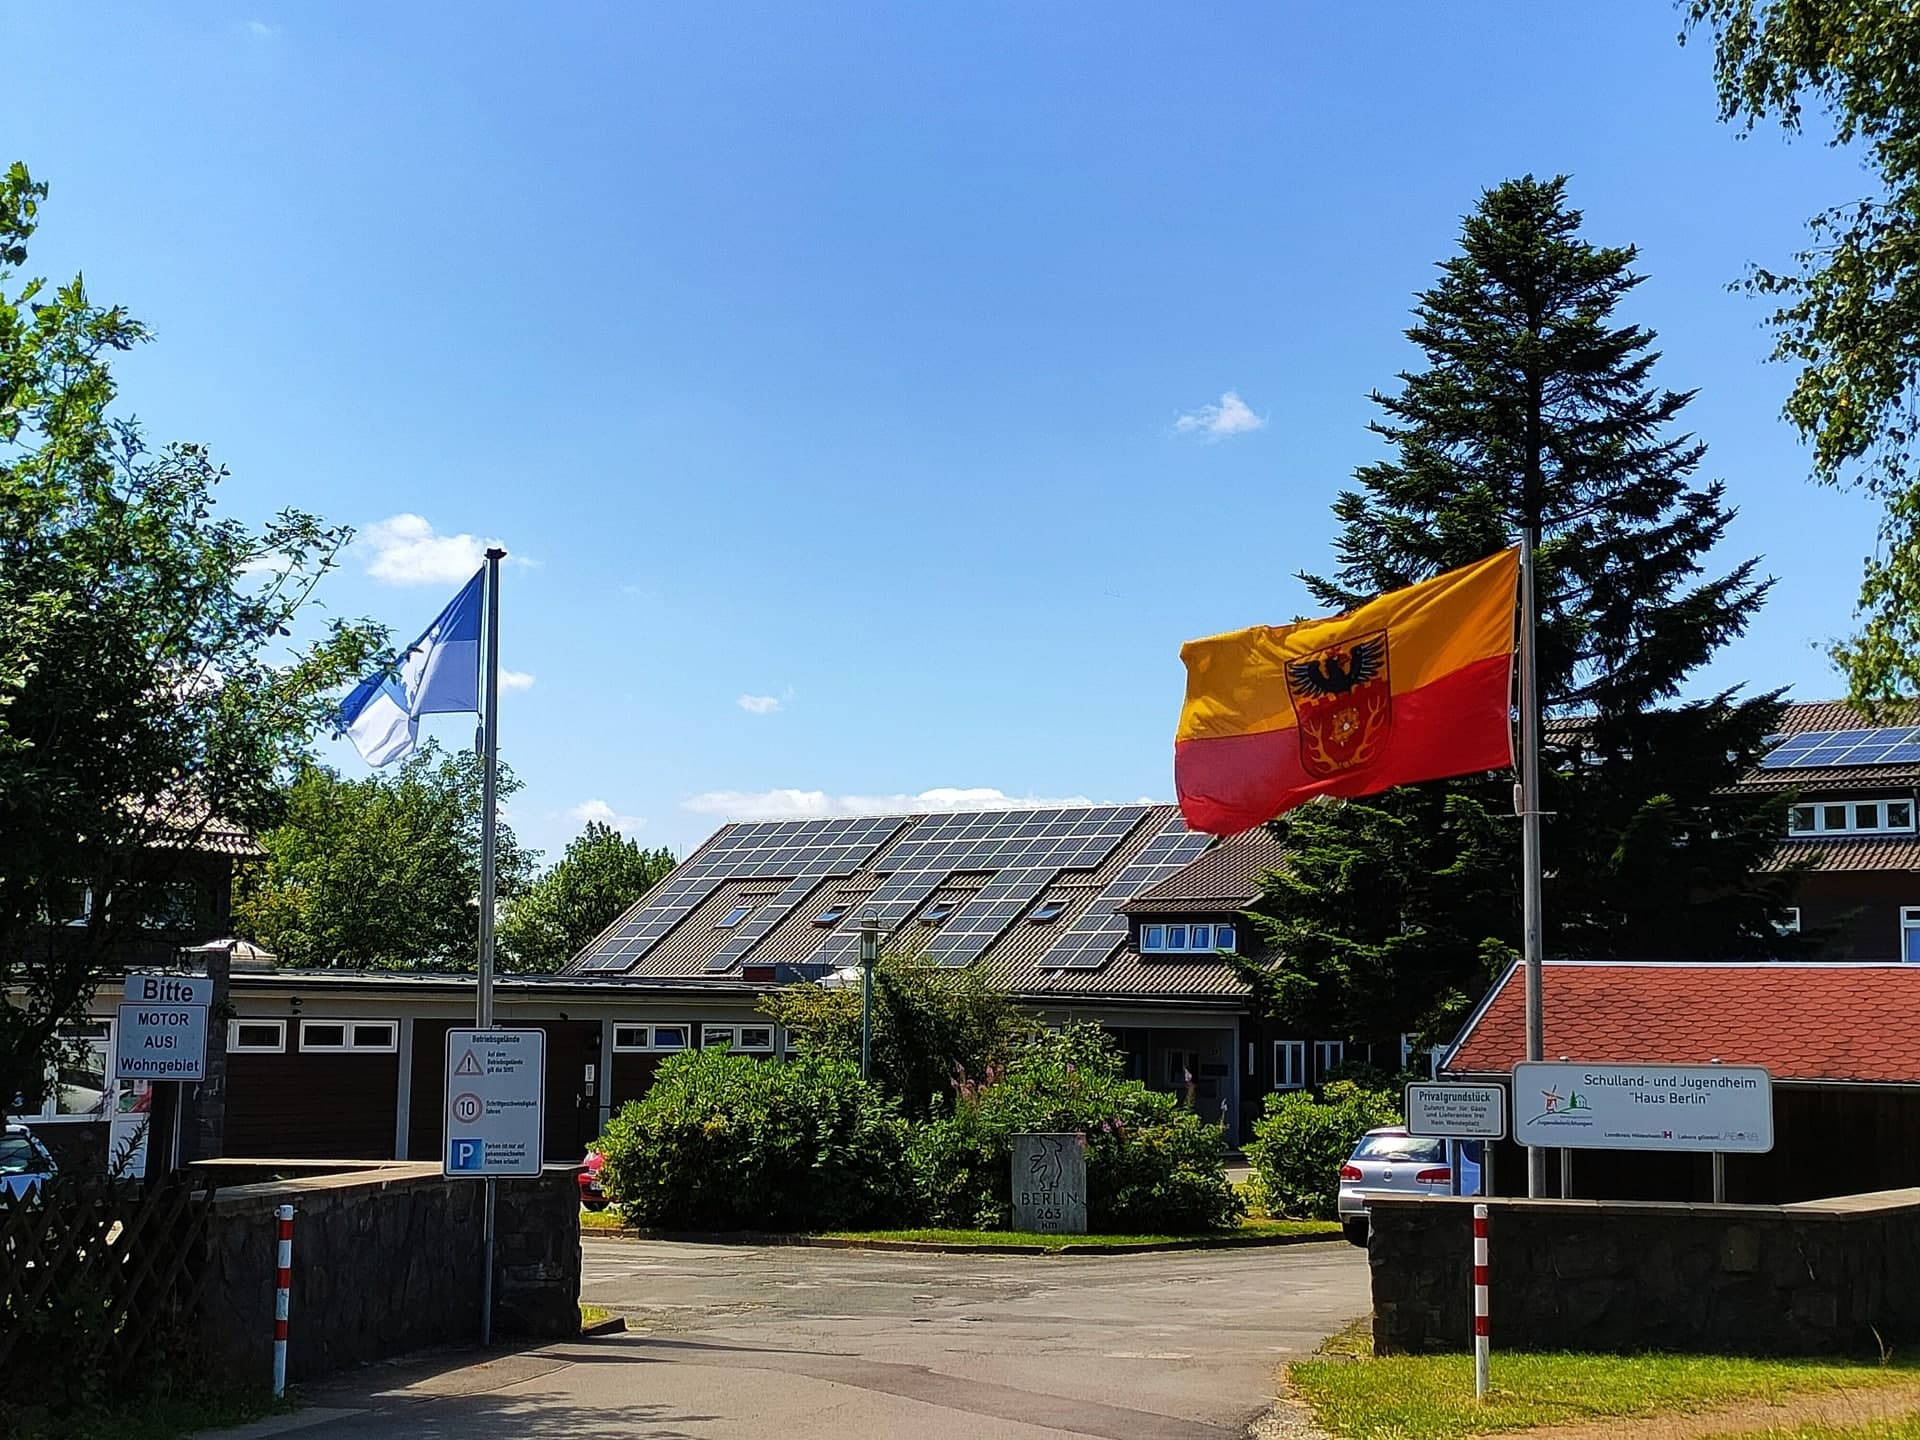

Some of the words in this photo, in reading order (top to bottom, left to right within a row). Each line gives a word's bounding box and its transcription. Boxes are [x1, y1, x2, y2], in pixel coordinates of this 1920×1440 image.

[143, 979, 194, 1002] Bitte
[138, 1013, 190, 1026] MOTOR
[120, 1057, 200, 1073] Wohngebiet
[1584, 1074, 1649, 1087] Schulland-
[1653, 1077, 1677, 1088] und
[1680, 1076, 1757, 1090] Jugendheim
[1419, 1091, 1491, 1104] Privatgrundstück
[460, 1101, 475, 1116] 10
[460, 1144, 474, 1166] P
[1021, 1192, 1078, 1205] BERLIN
[1037, 1208, 1062, 1220] 263
